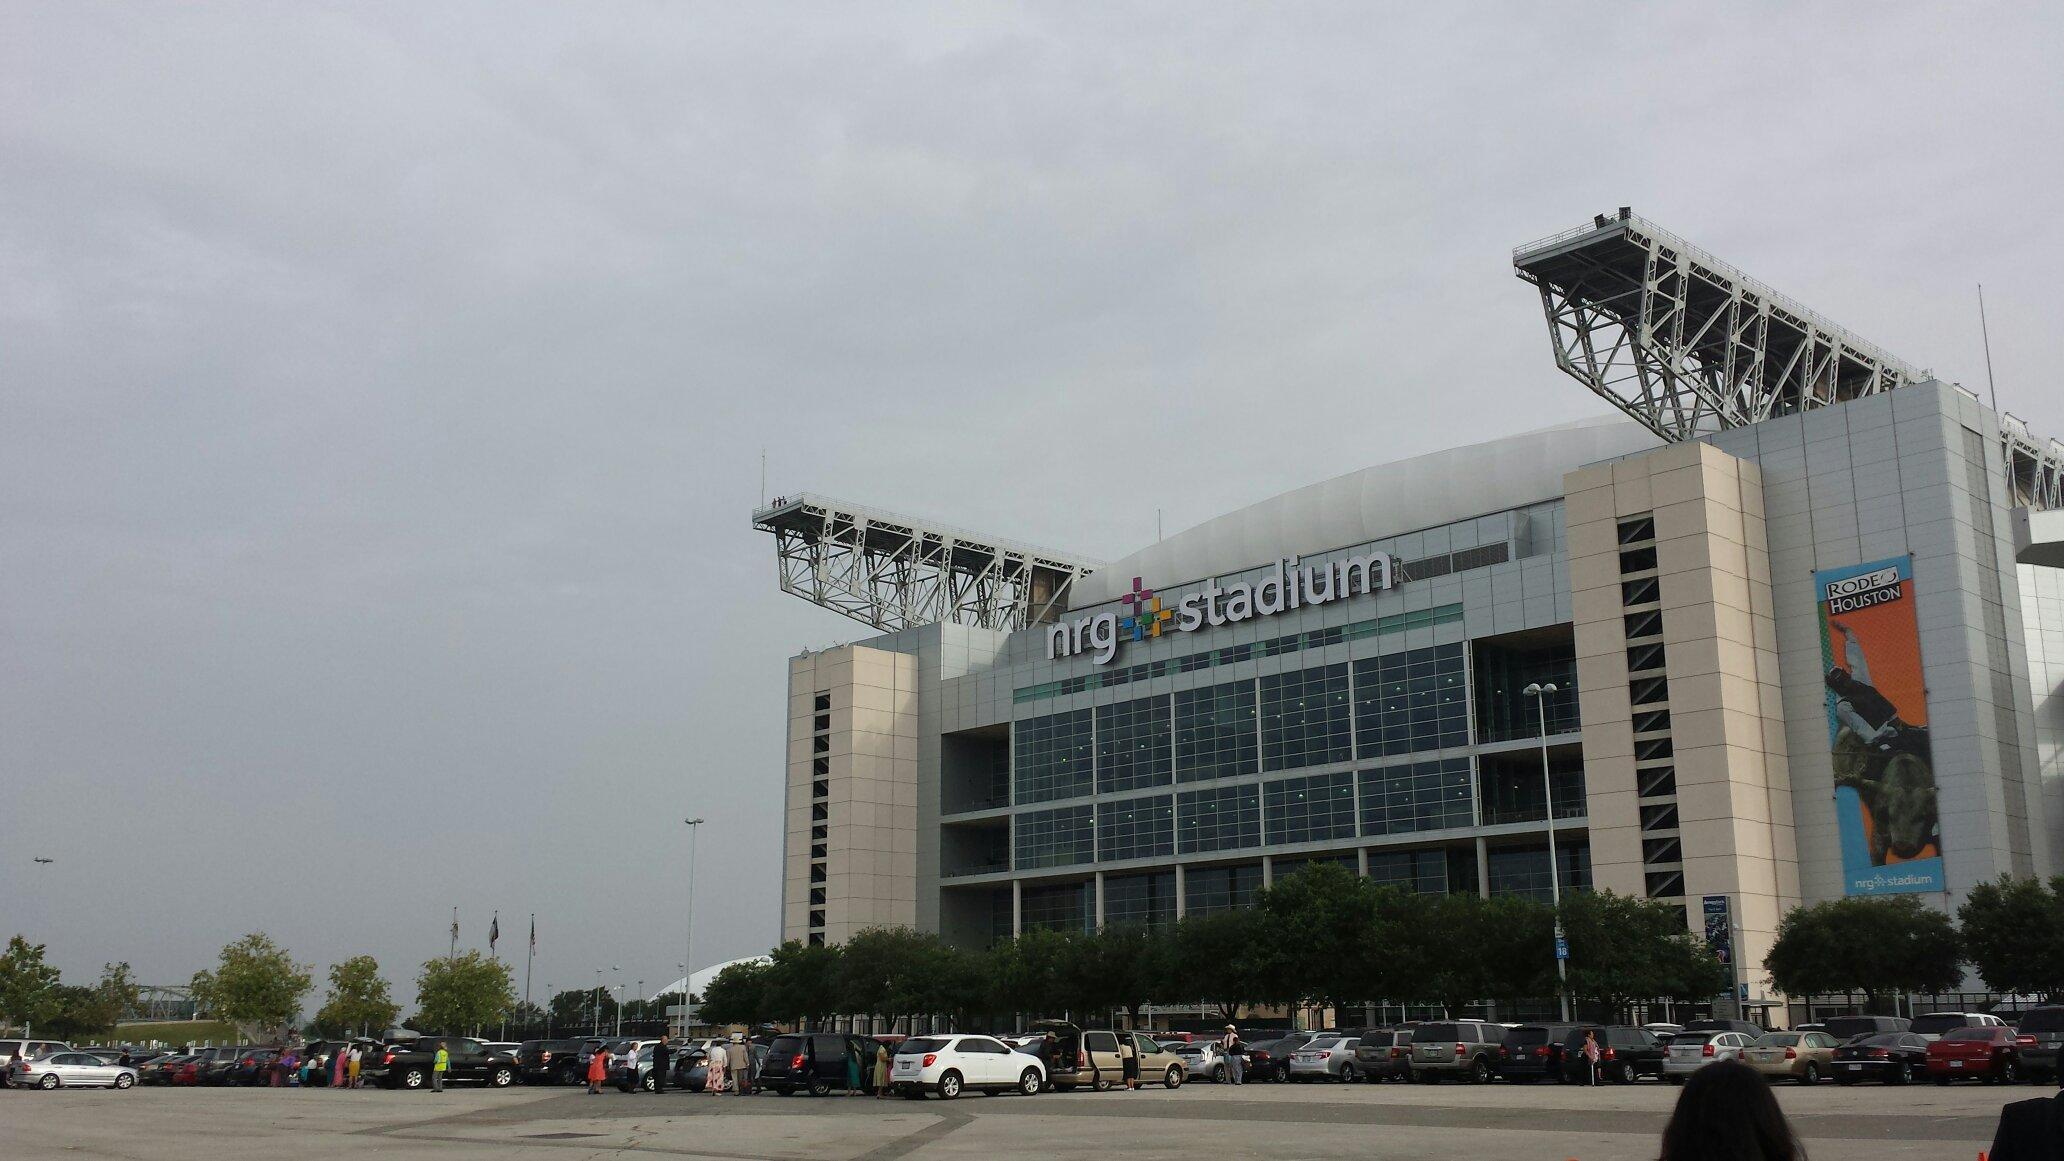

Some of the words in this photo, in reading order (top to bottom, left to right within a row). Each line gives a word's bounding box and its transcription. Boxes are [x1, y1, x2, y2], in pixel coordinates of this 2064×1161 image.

[1827, 572, 1897, 597] RODEO
[1046, 611, 1118, 665] nrg
[1178, 550, 1393, 632] stadium
[1830, 585, 1901, 613] HOUSTON
[1855, 879, 1875, 890] nrg
[1887, 873, 1933, 886] stadium
[1557, 947, 1567, 955] 18
